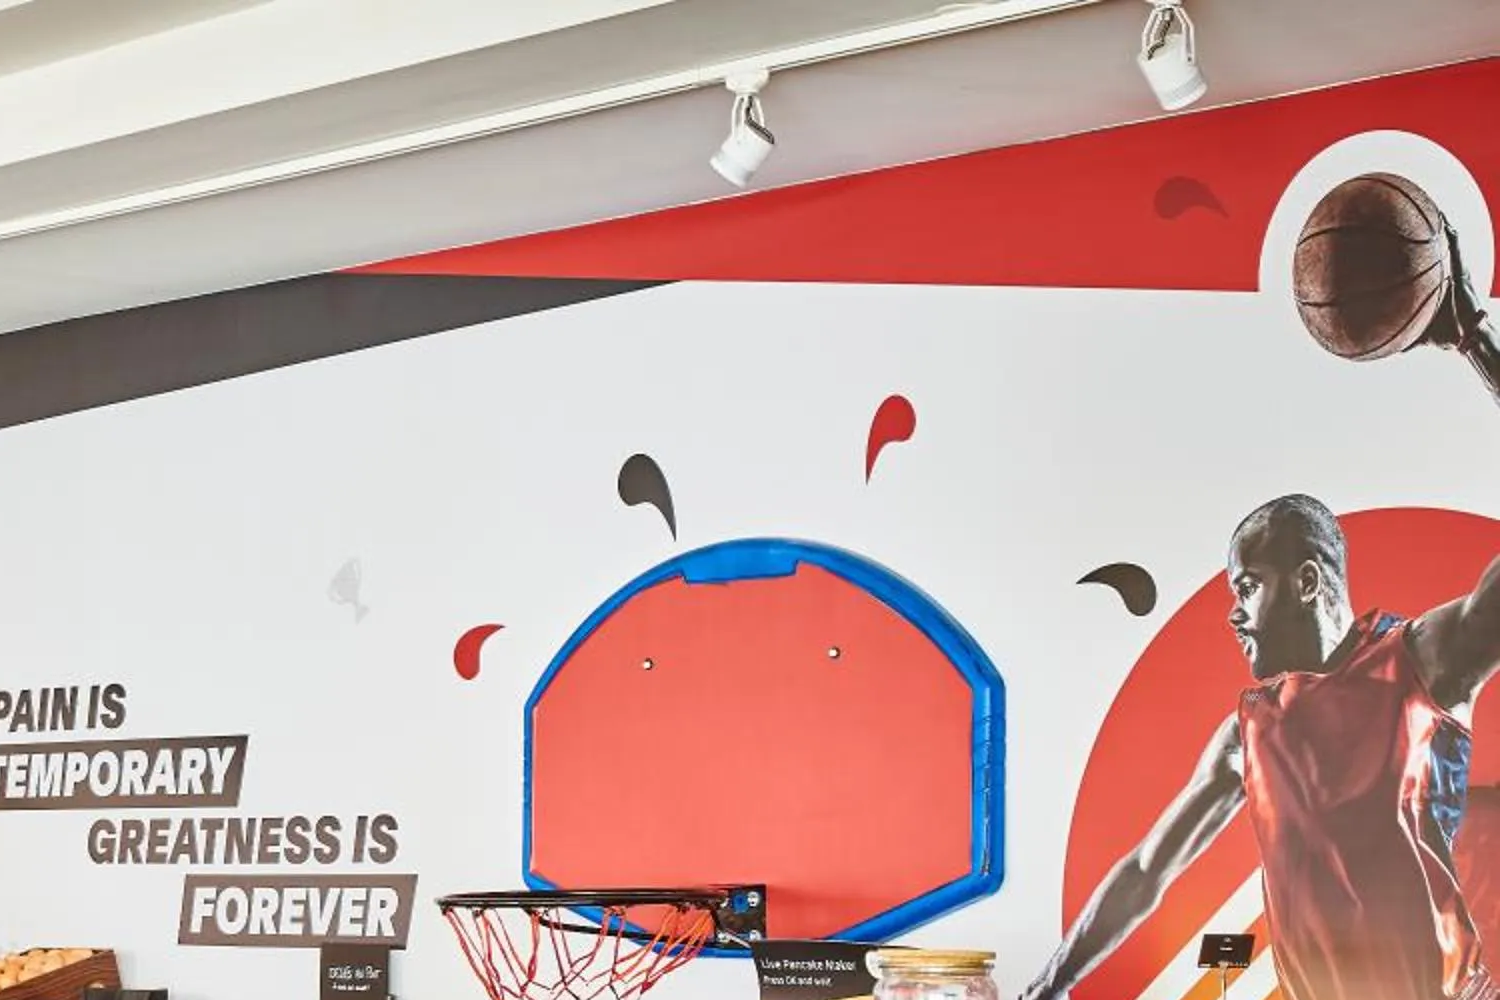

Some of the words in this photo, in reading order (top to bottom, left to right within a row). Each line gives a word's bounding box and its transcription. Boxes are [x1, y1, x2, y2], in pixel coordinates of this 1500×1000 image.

[86, 683, 127, 730] IS
[87, 814, 342, 865] GREATNESS
[352, 813, 400, 864] IS
[189, 886, 400, 938] FOREVER
[761, 958, 782, 970] Live
[783, 959, 823, 970] Pancake
[825, 960, 857, 972] Maker
